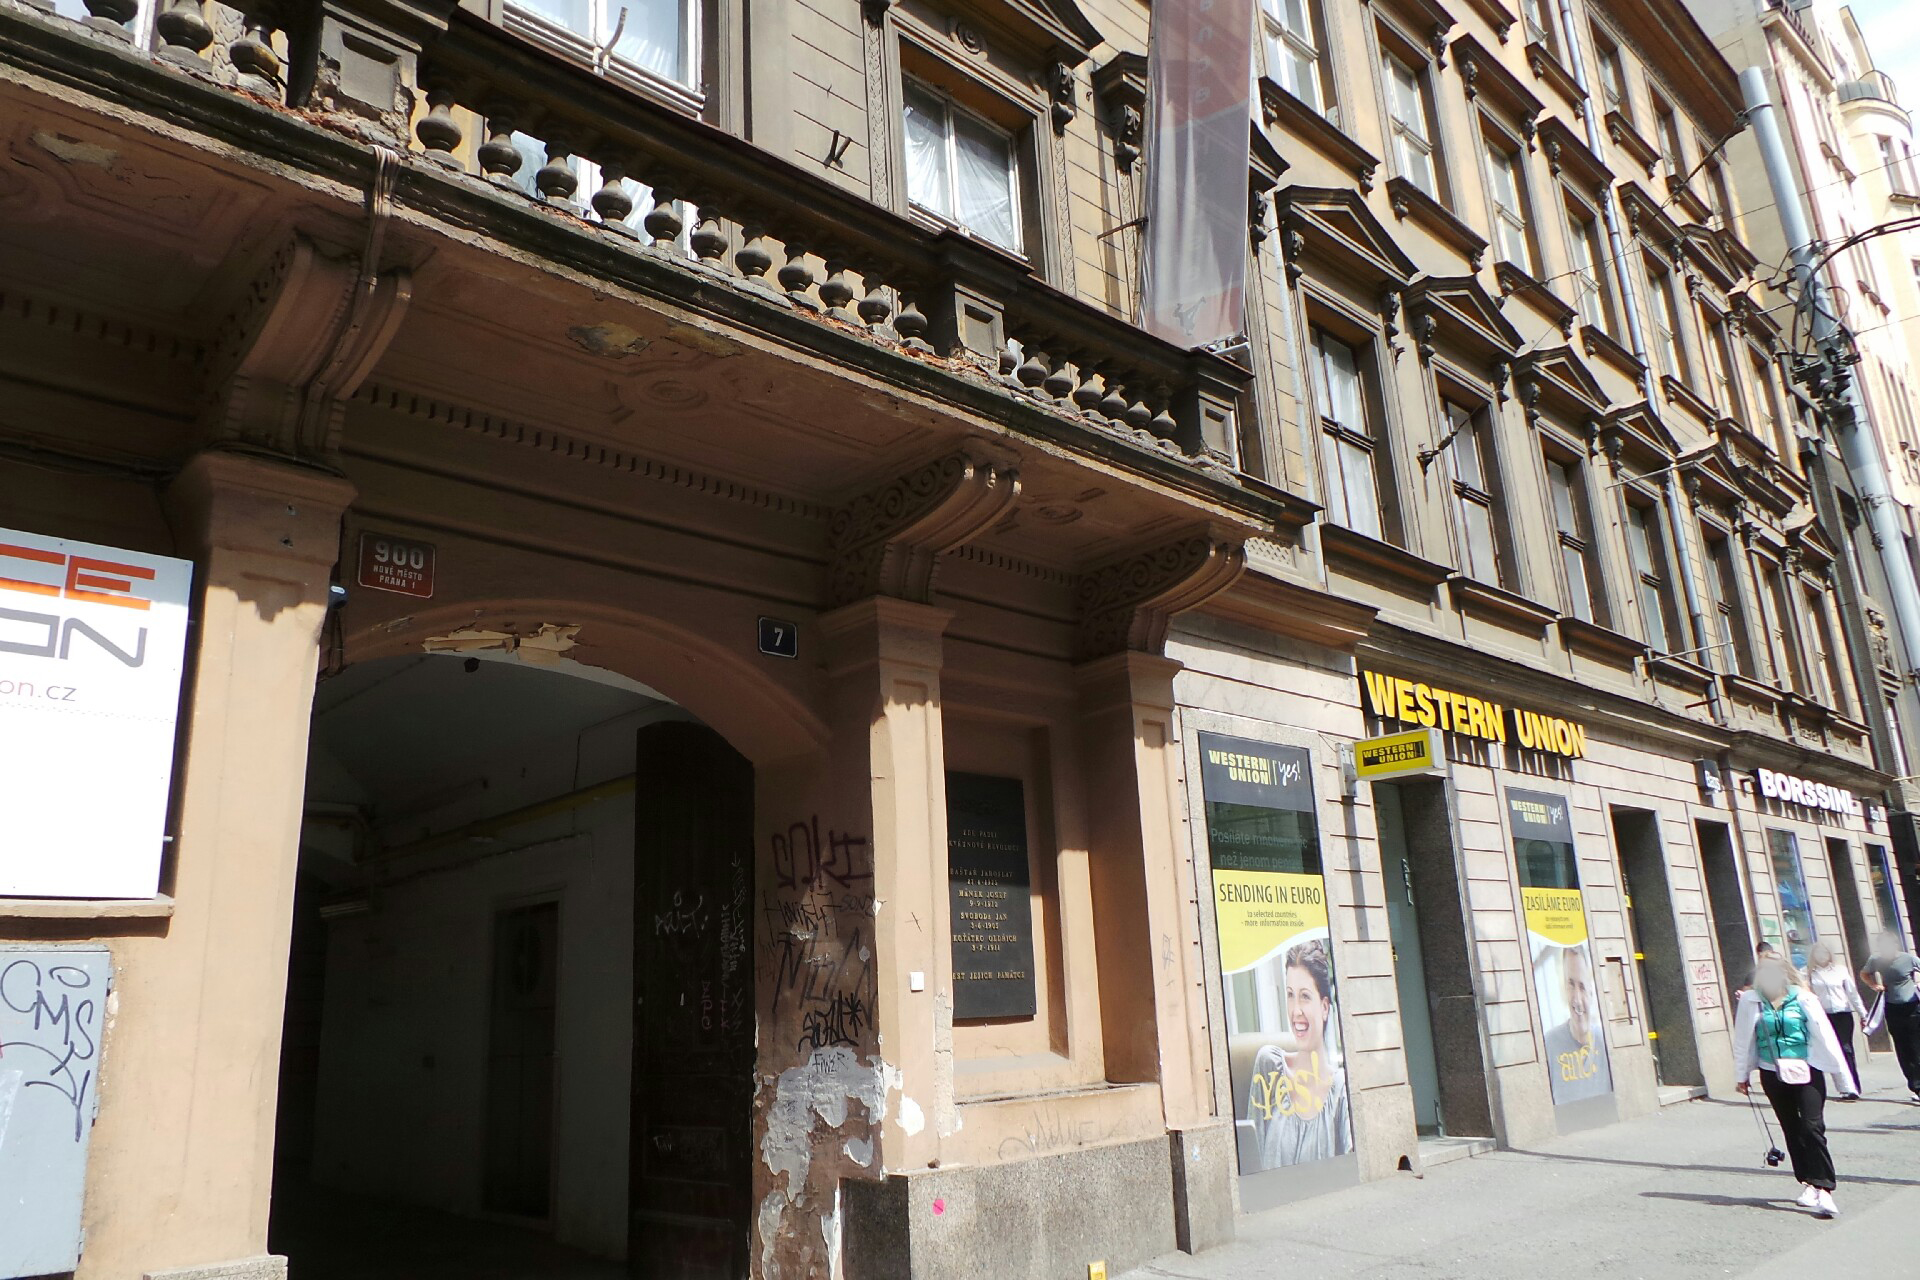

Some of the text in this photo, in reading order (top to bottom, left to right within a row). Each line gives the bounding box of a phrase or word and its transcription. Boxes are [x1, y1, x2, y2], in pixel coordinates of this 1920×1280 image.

[374, 541, 424, 570] 900
[373, 565, 423, 581] NOVÉ MĚSTO
[379, 575, 406, 588] PRAHA
[774, 627, 784, 647] 7
[1364, 670, 1587, 758] WESTERN UNION
[1363, 743, 1414, 758] WESTERN
[1379, 751, 1415, 763] UNION
[1208, 750, 1268, 771] WESTERN
[1228, 760, 1301, 787] UNION yes!
[1758, 768, 1853, 814] BORSSINI
[1510, 799, 1547, 815] WESTERN
[1522, 812, 1548, 825] UNION
[1220, 852, 1238, 866] než
[1239, 853, 1270, 868] jenom
[986, 891, 1007, 899] JOSEF
[1219, 883, 1321, 905] SENDING IN EURO
[1525, 894, 1581, 912] ZASÍLÁME EURO
[960, 912, 1008, 921] SVOBODA JAN
[1253, 910, 1274, 918] selected
[1274, 910, 1298, 918] countries
[1259, 919, 1289, 927] information
